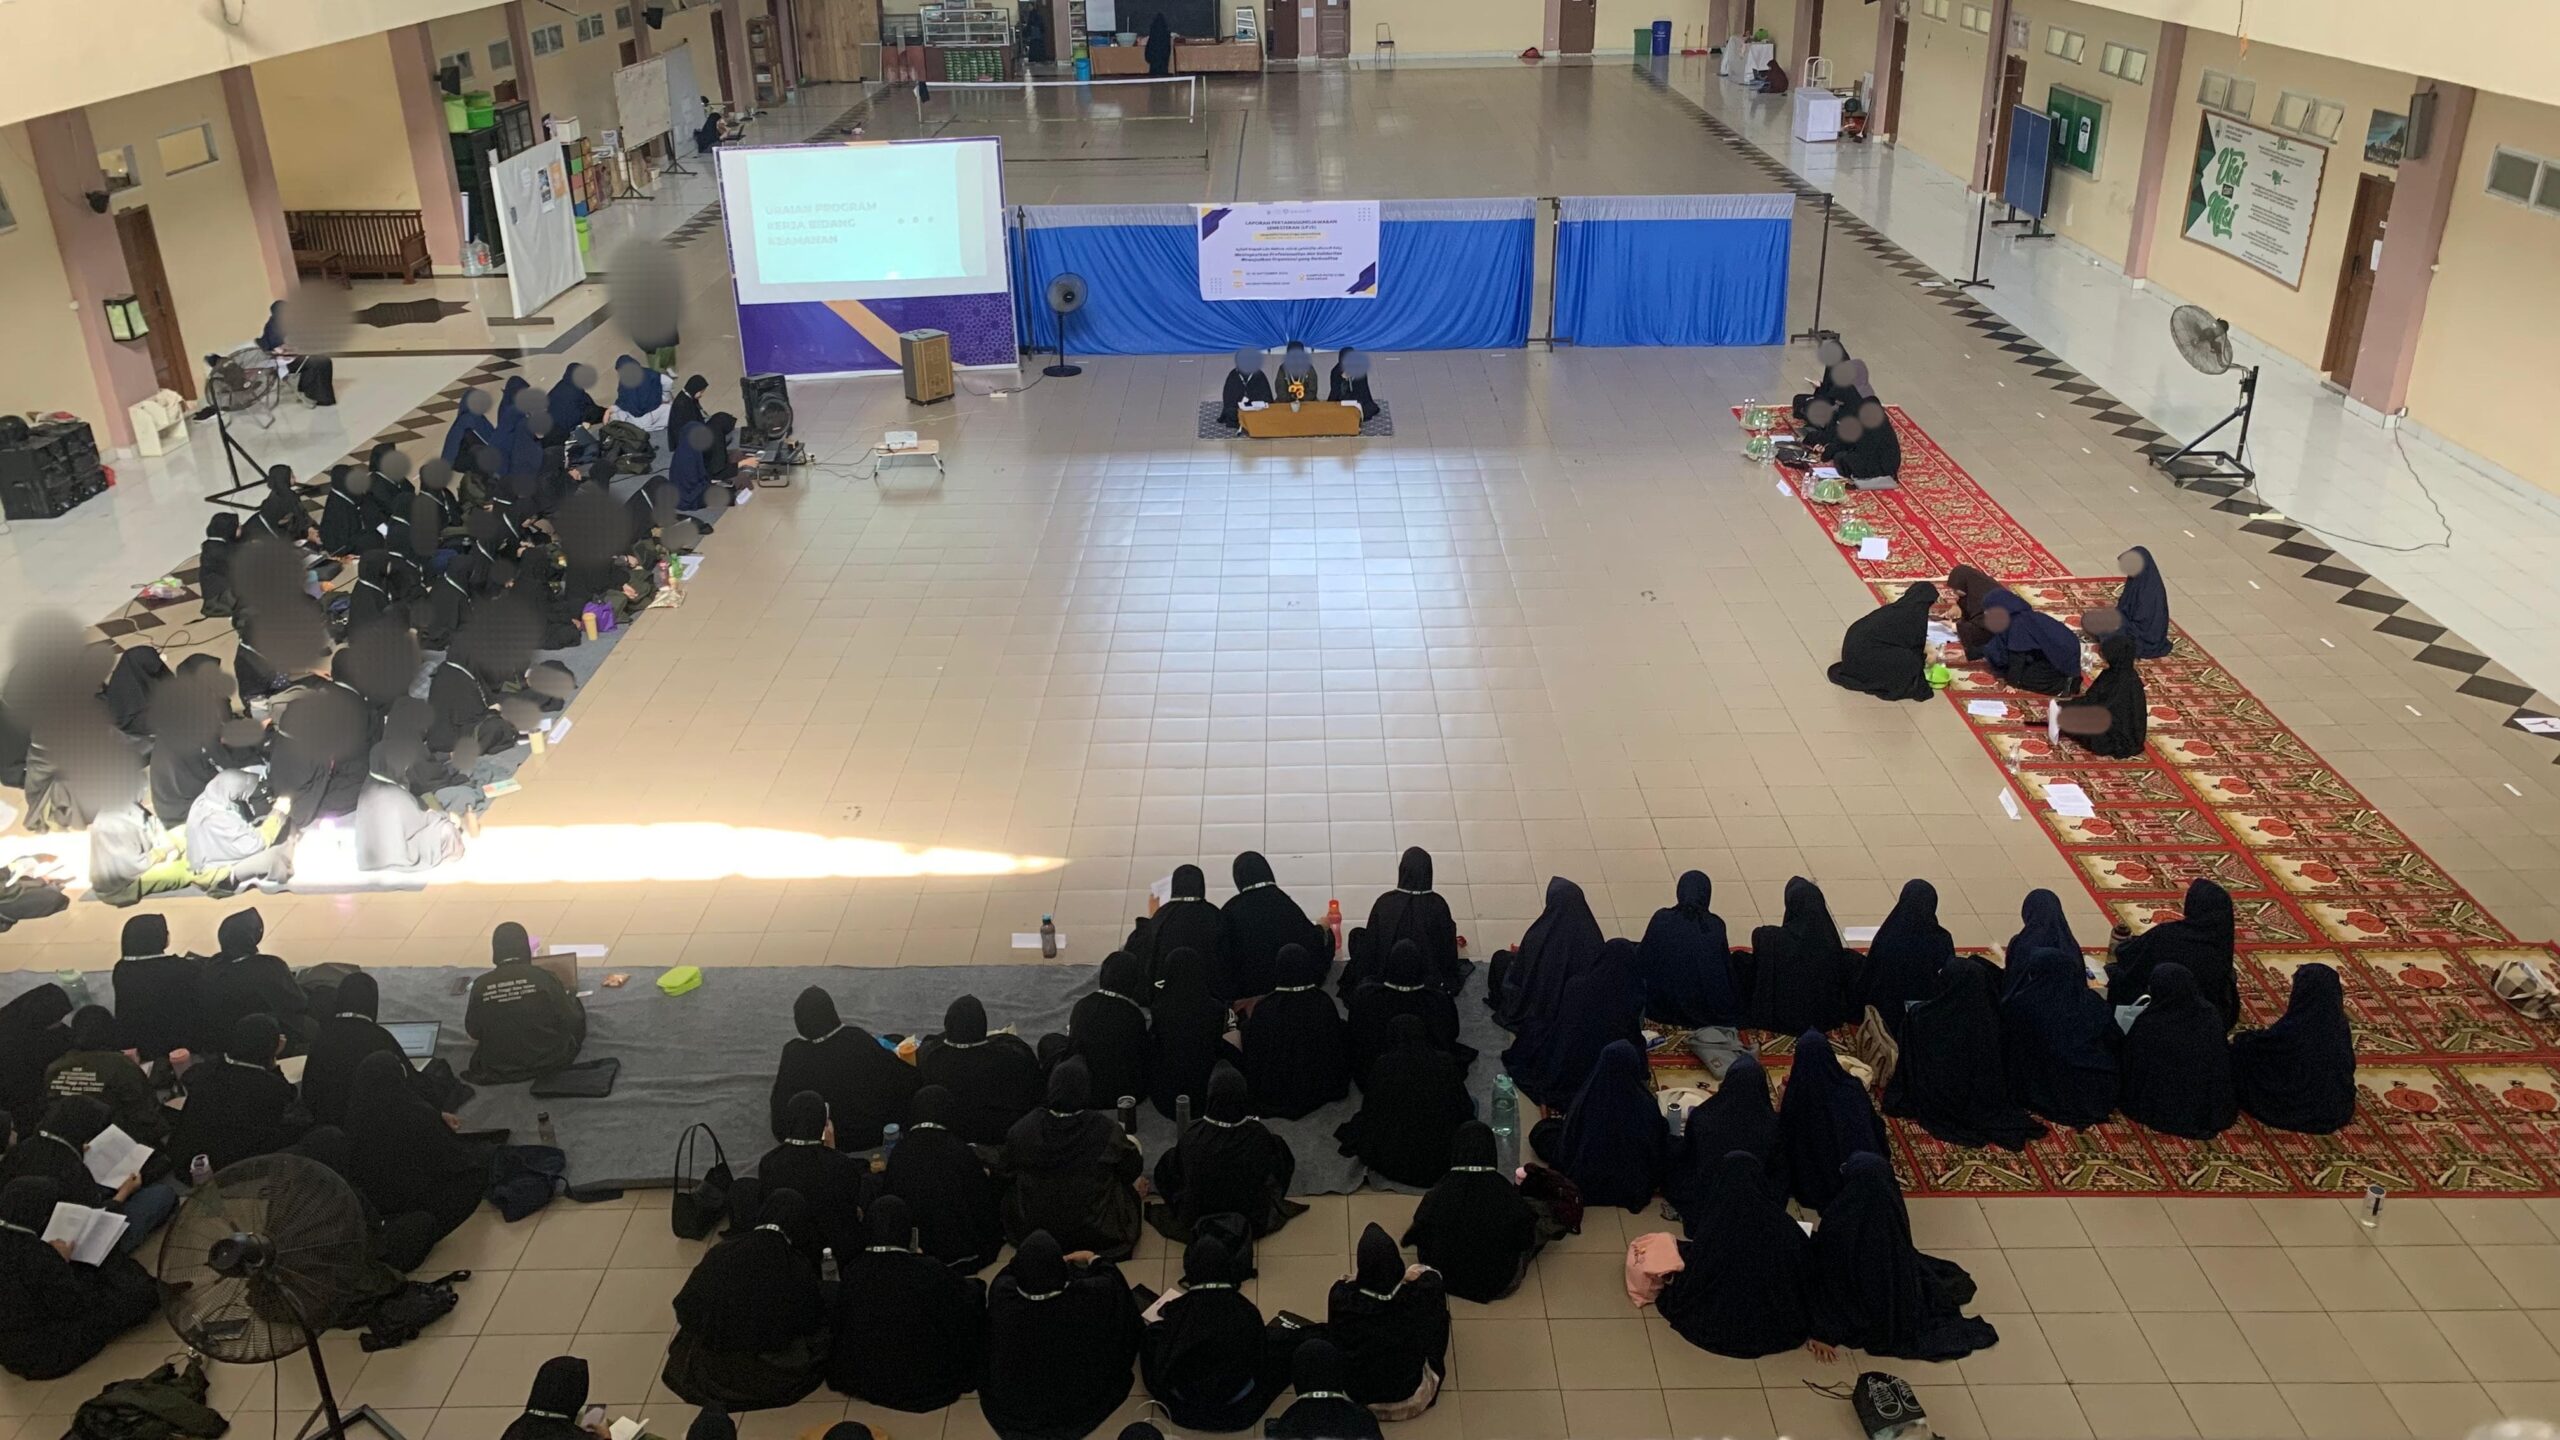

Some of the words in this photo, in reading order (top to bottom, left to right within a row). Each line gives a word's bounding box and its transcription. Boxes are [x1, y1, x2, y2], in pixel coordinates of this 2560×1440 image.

[2216, 147, 2248, 187] Visi
[815, 201, 877, 212] PROGRAM
[2207, 190, 2239, 240] Misi
[808, 218, 856, 229] BIDANG
